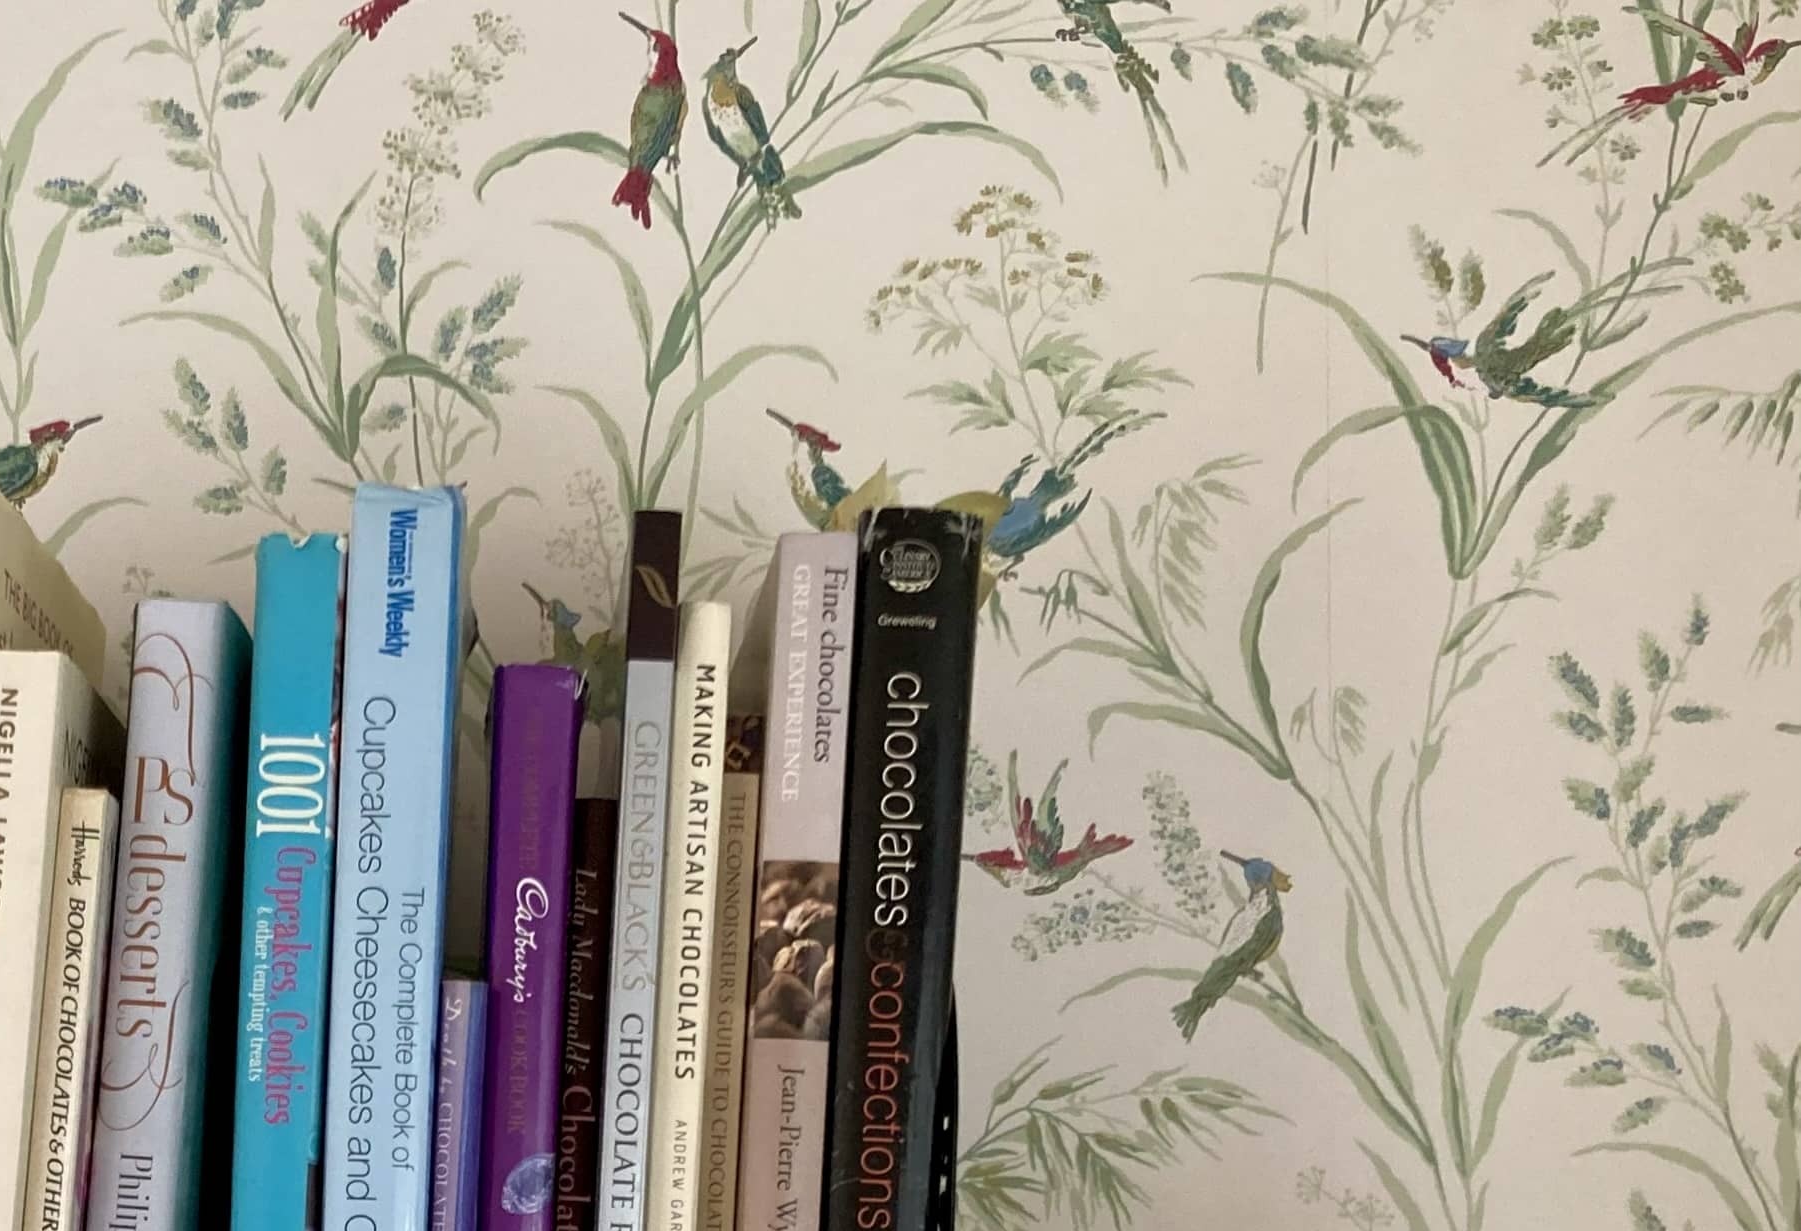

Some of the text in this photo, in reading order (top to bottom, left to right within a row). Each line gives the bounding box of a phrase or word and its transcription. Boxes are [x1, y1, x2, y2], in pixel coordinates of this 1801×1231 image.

[378, 507, 418, 658] Women's Weekly
[877, 613, 937, 630] Greweling
[781, 565, 812, 801] GREAT EXPERIENCE
[814, 565, 849, 763] Fine chocolates
[255, 732, 326, 838] 1001
[356, 696, 397, 874] Cupcakes
[727, 792, 746, 834] THE
[874, 671, 930, 927] chocolates
[66, 820, 100, 887] Harrods
[567, 868, 600, 927] Lady
[675, 664, 716, 1079] MAKING ARTISAN CHOCOLATES
[63, 964, 81, 993] OF
[64, 897, 86, 961] BOOK
[116, 832, 187, 1039] desserts
[255, 919, 275, 961] other
[506, 877, 549, 1004] Cadbury's
[247, 964, 271, 1032] tempting
[348, 886, 389, 1125] Cheesecakes
[391, 887, 425, 1172] The Complete Book of
[713, 1012, 733, 1077] GUIDE
[50, 995, 79, 1137] CHOCOLATES
[248, 1037, 268, 1083] treats
[263, 1010, 309, 1126] Cookies
[611, 1013, 644, 1210] CHOCOLATE
[710, 1084, 729, 1119] TO
[858, 961, 910, 1229] confections
[48, 1138, 65, 1154] &
[346, 1136, 377, 1201] and
[671, 1119, 688, 1191] ANDREW
[776, 1064, 805, 1192] Jean-Pierre
[43, 1157, 65, 1231] OTHER
